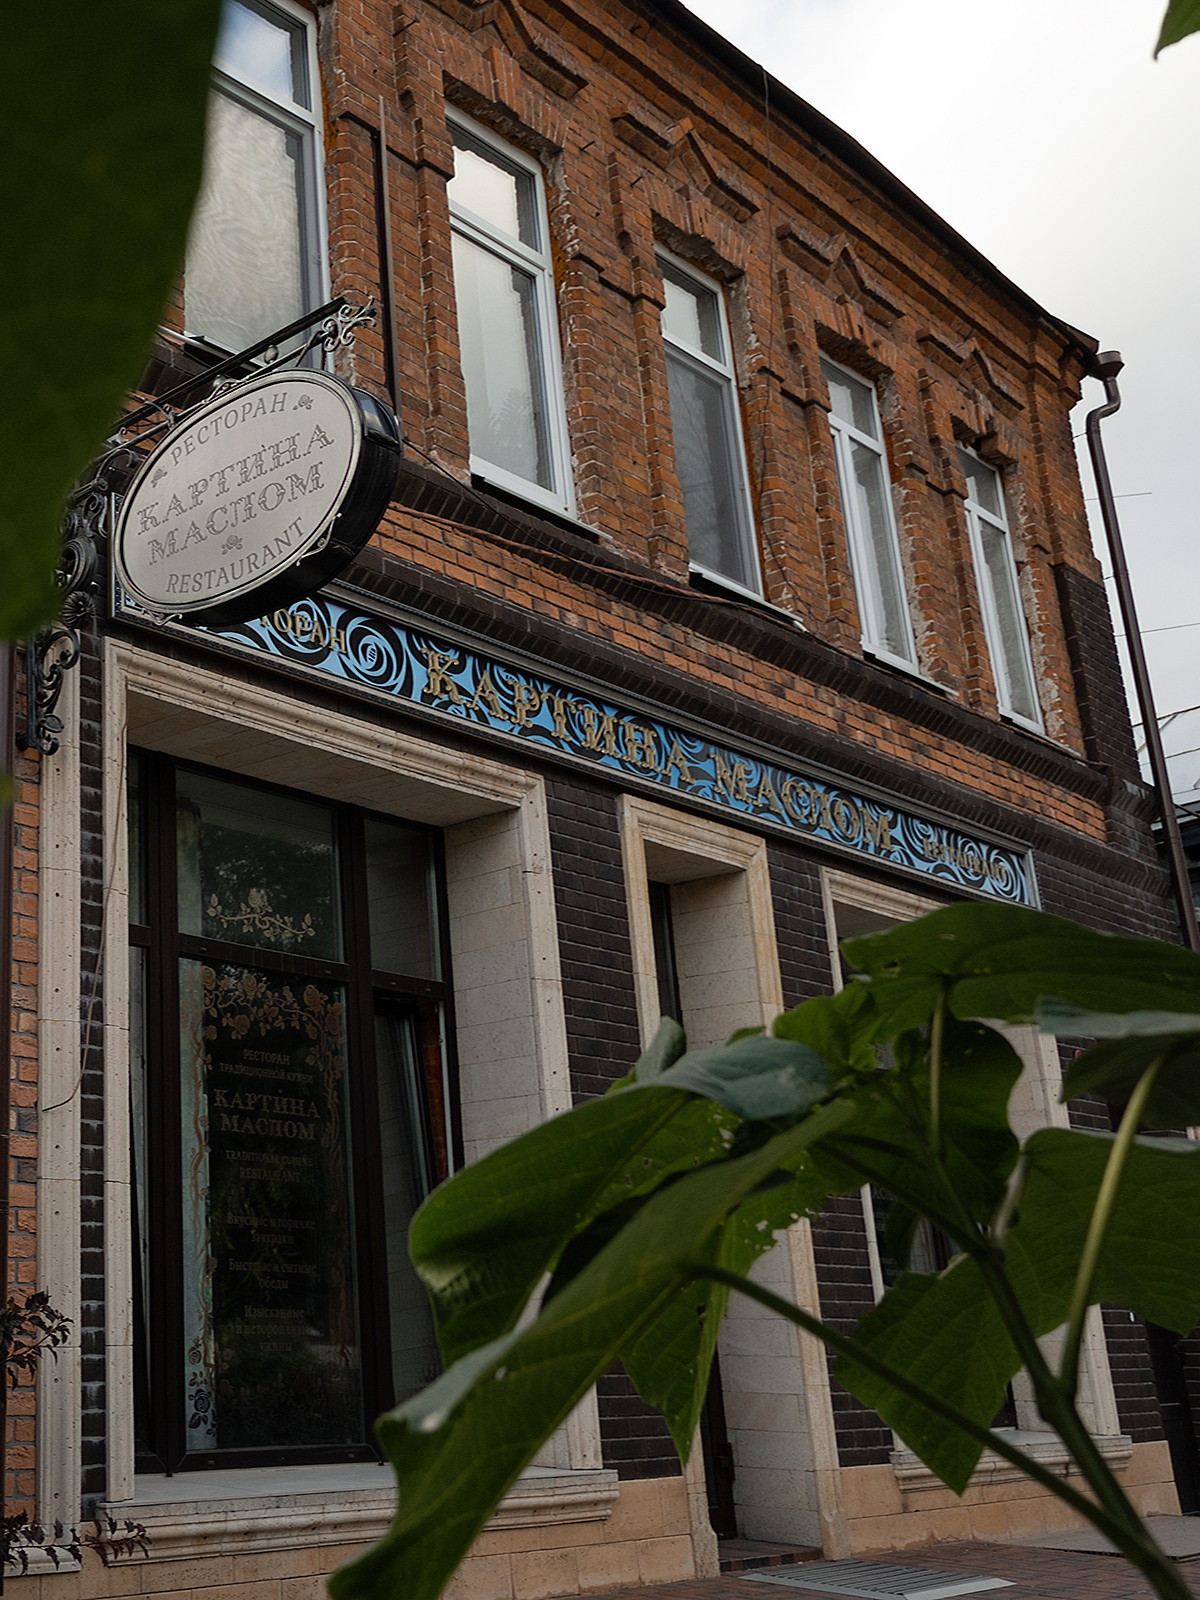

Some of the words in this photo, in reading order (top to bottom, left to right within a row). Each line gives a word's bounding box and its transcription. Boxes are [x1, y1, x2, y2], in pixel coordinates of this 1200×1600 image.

[170, 392, 288, 466] РЕСТОРАН
[137, 424, 335, 535] КАРТИНА
[148, 461, 325, 566] МАСЛОМ
[166, 517, 305, 594] RESTAURANT
[421, 647, 696, 783] КАРТИНА
[709, 752, 896, 851] МАСЛОМ
[922, 837, 1006, 884] RESTAURANT
[243, 1048, 290, 1065] РЕСТОРАН
[219, 1062, 285, 1081] ТРАДИЦИОННОЙ
[287, 1072, 313, 1084] КУХНИ
[212, 1088, 321, 1118] КАРТИНА
[220, 1113, 317, 1142] МАСЛОМ
[225, 1149, 280, 1164] TRADITIONAL
[281, 1154, 313, 1168] CUISINE
[239, 1166, 301, 1183] RESTAURANT
[227, 1211, 268, 1228] Вкусные
[228, 1258, 271, 1274] Быстрые
